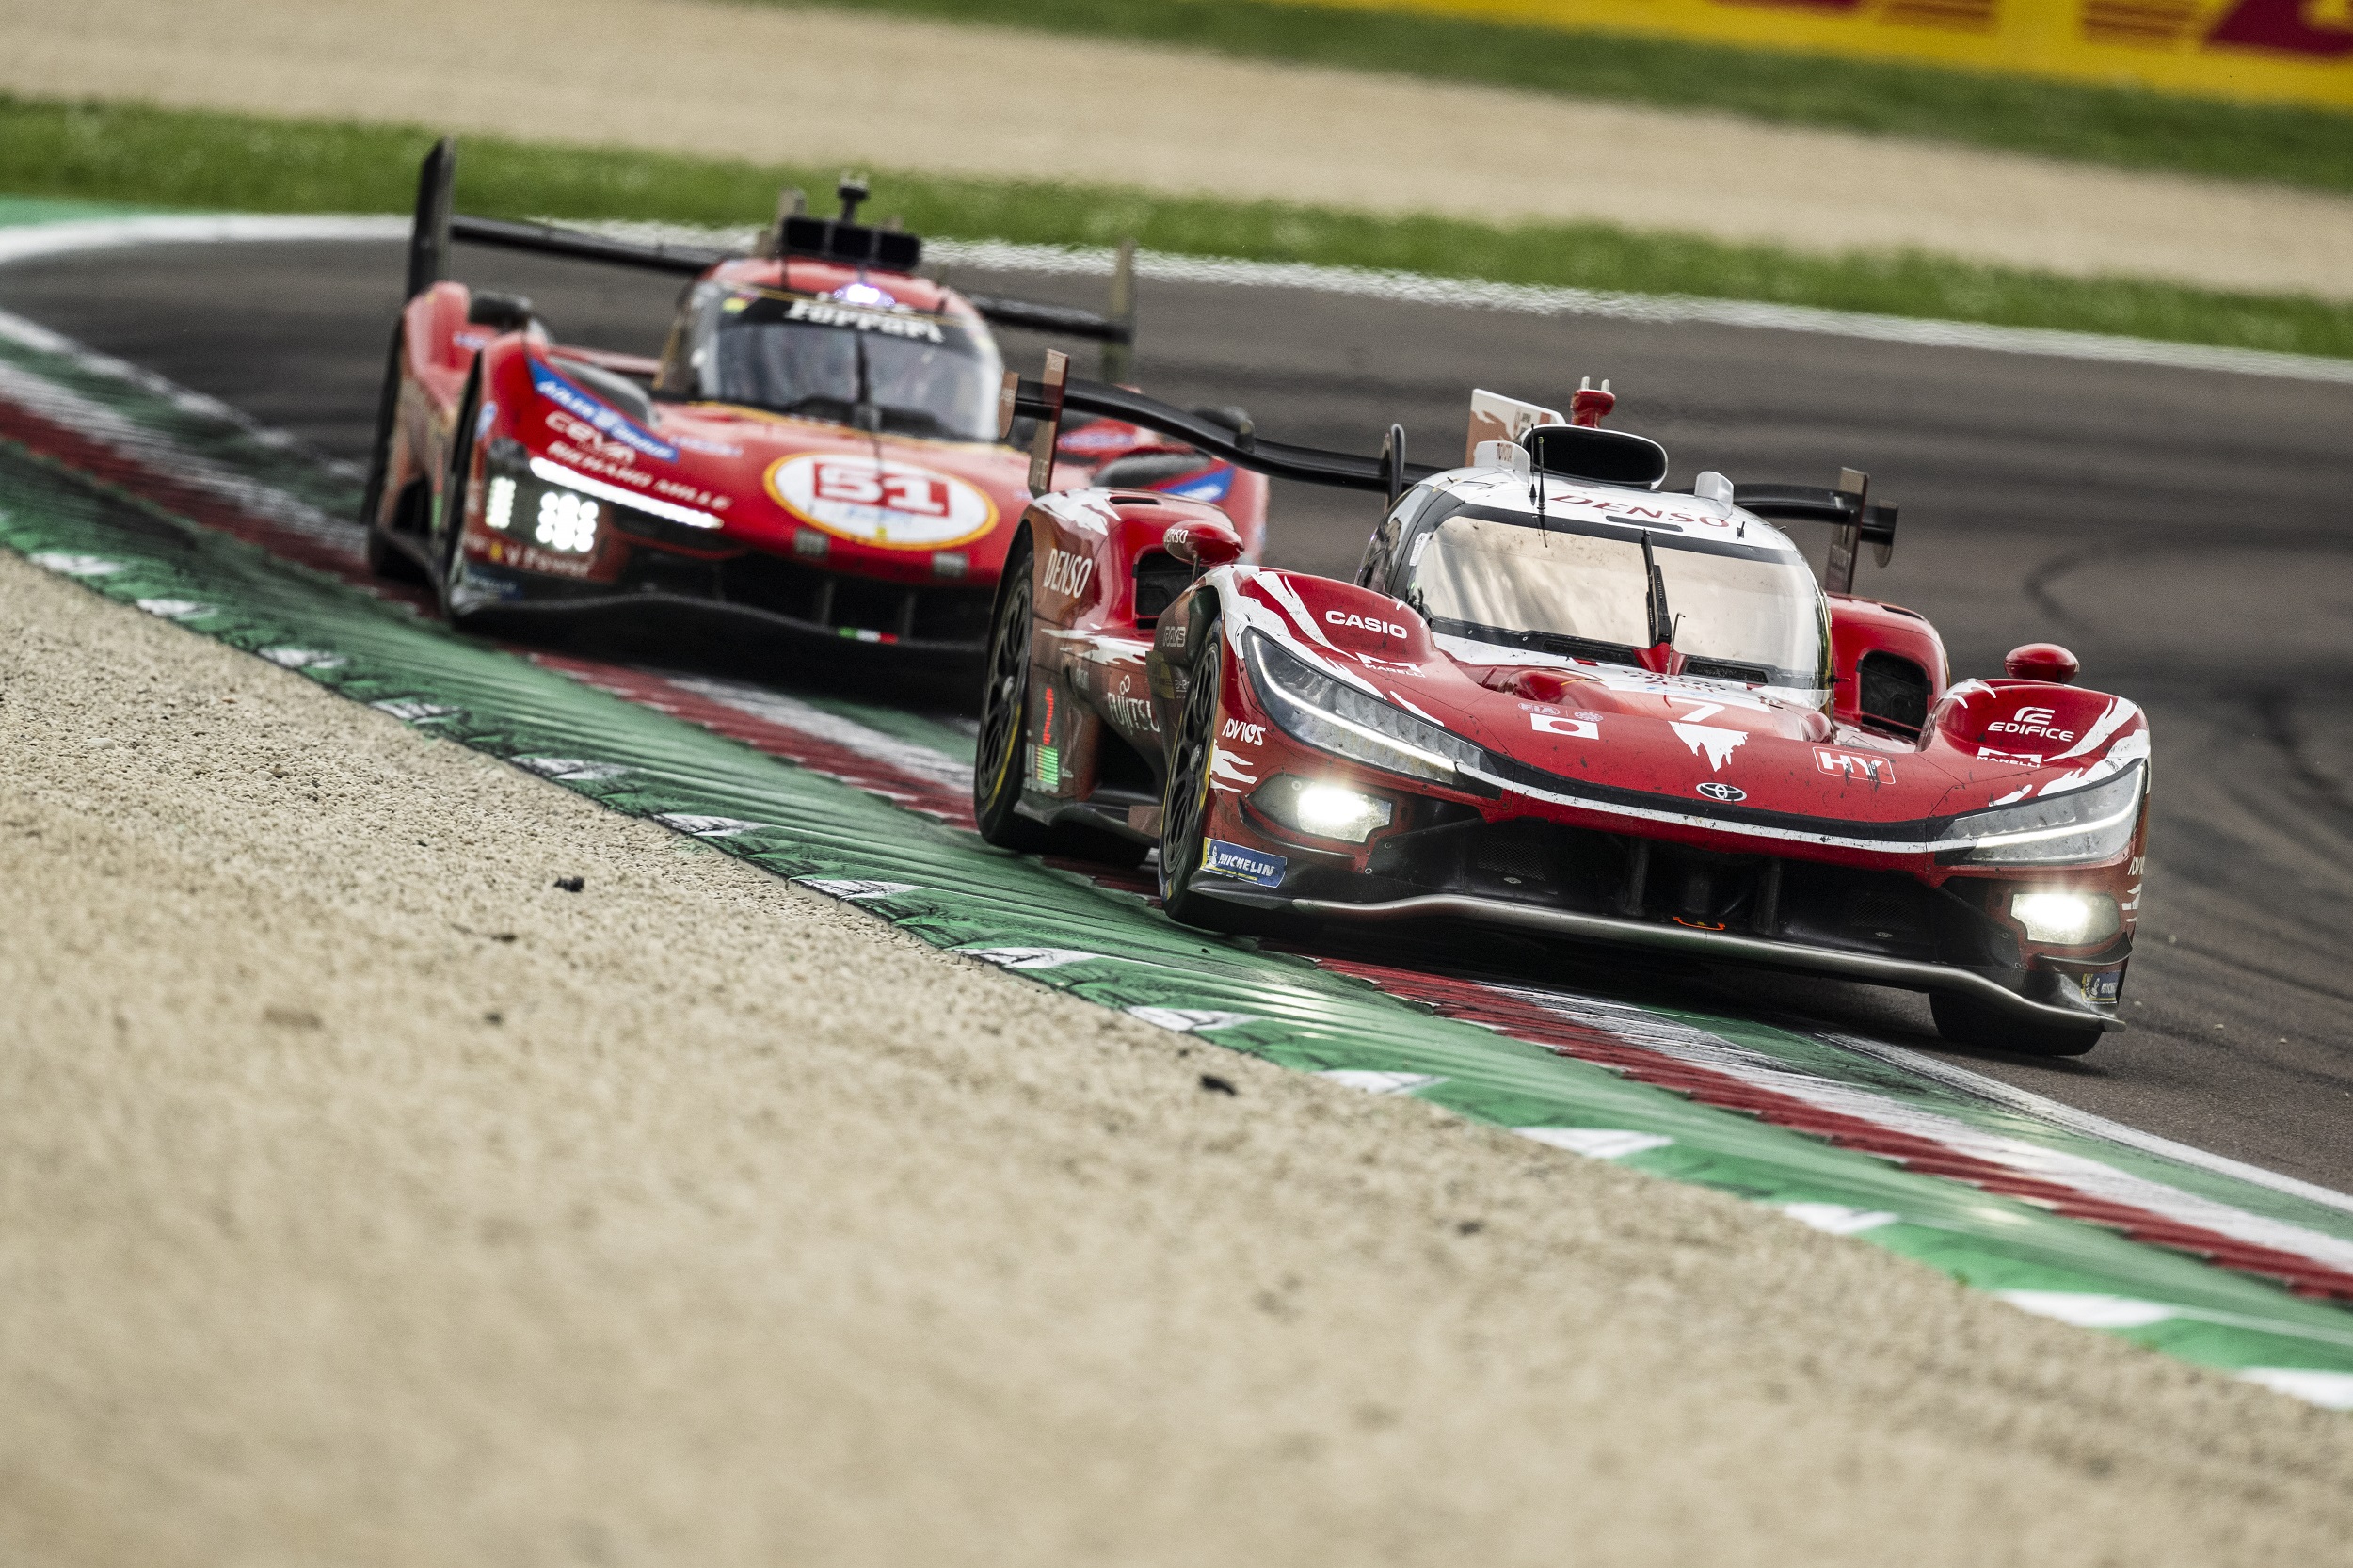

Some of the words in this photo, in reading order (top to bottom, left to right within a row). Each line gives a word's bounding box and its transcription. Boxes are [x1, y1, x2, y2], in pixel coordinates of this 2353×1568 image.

[818, 465, 945, 515] 51
[1548, 494, 1730, 528] DENSO
[1163, 528, 1189, 544] DENSO
[1043, 548, 1093, 599] DENSO
[1325, 610, 1408, 639] CASIO
[1364, 664, 1426, 678] MARELLI
[1987, 721, 2074, 743] EDIFICE
[1819, 751, 1883, 777] HY
[1977, 755, 2041, 769] MARELLI
[1218, 853, 1275, 877] MICHELIN
